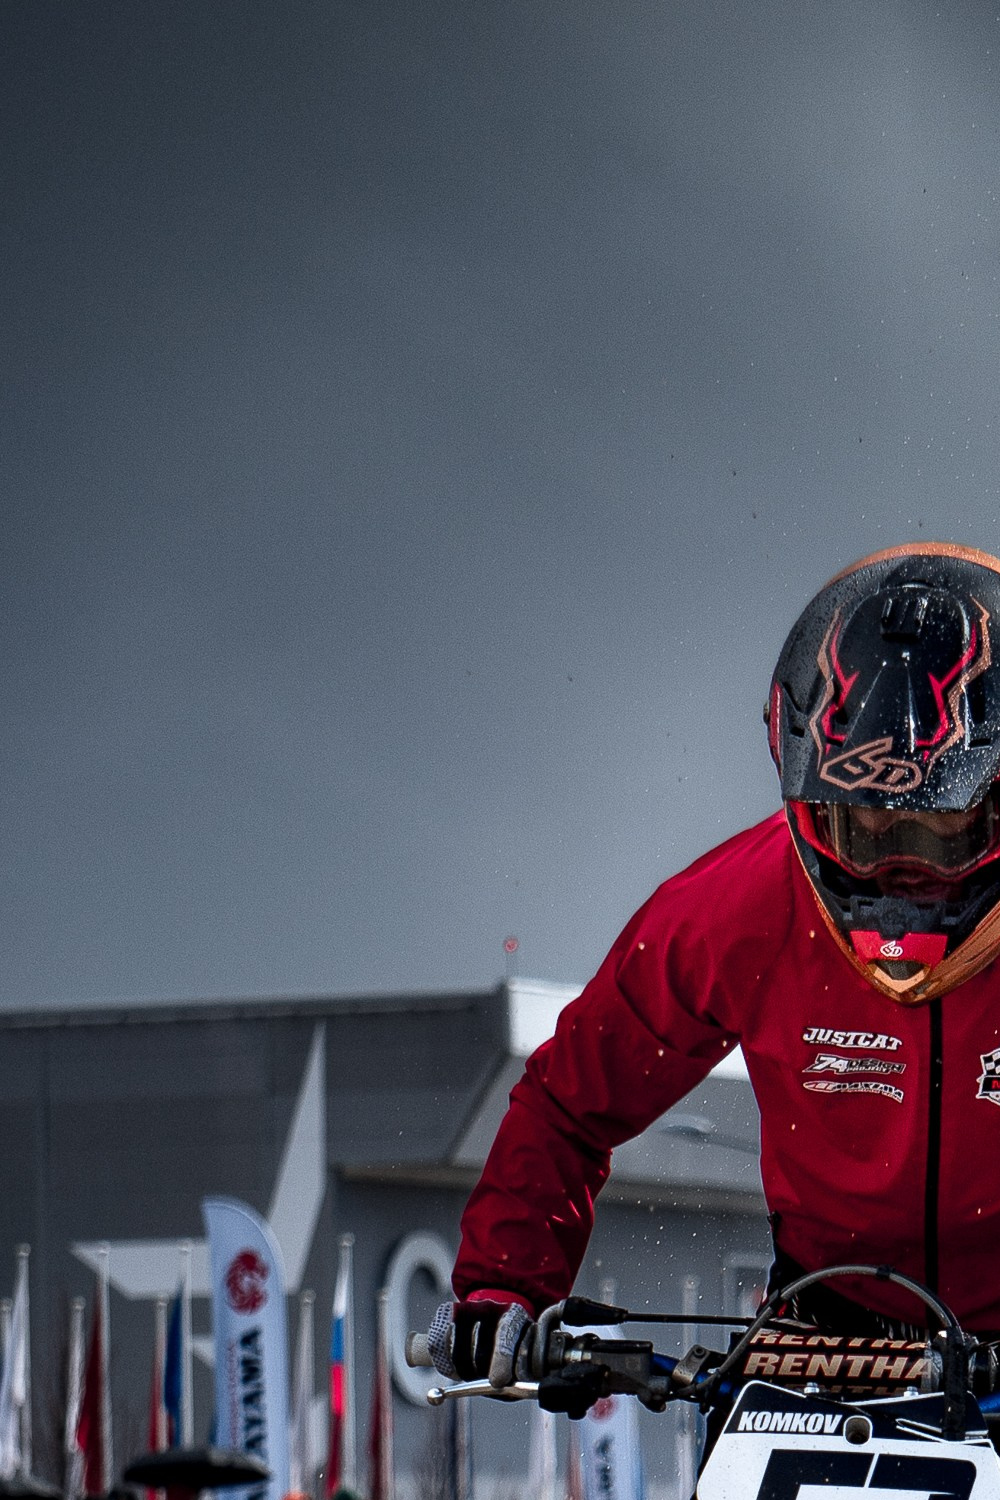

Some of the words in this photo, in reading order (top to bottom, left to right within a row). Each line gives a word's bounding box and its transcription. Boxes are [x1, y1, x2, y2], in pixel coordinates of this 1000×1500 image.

[803, 1027, 902, 1051] JUSTCAT
[813, 1056, 848, 1073] 74
[737, 1411, 842, 1434] KOMKOV
